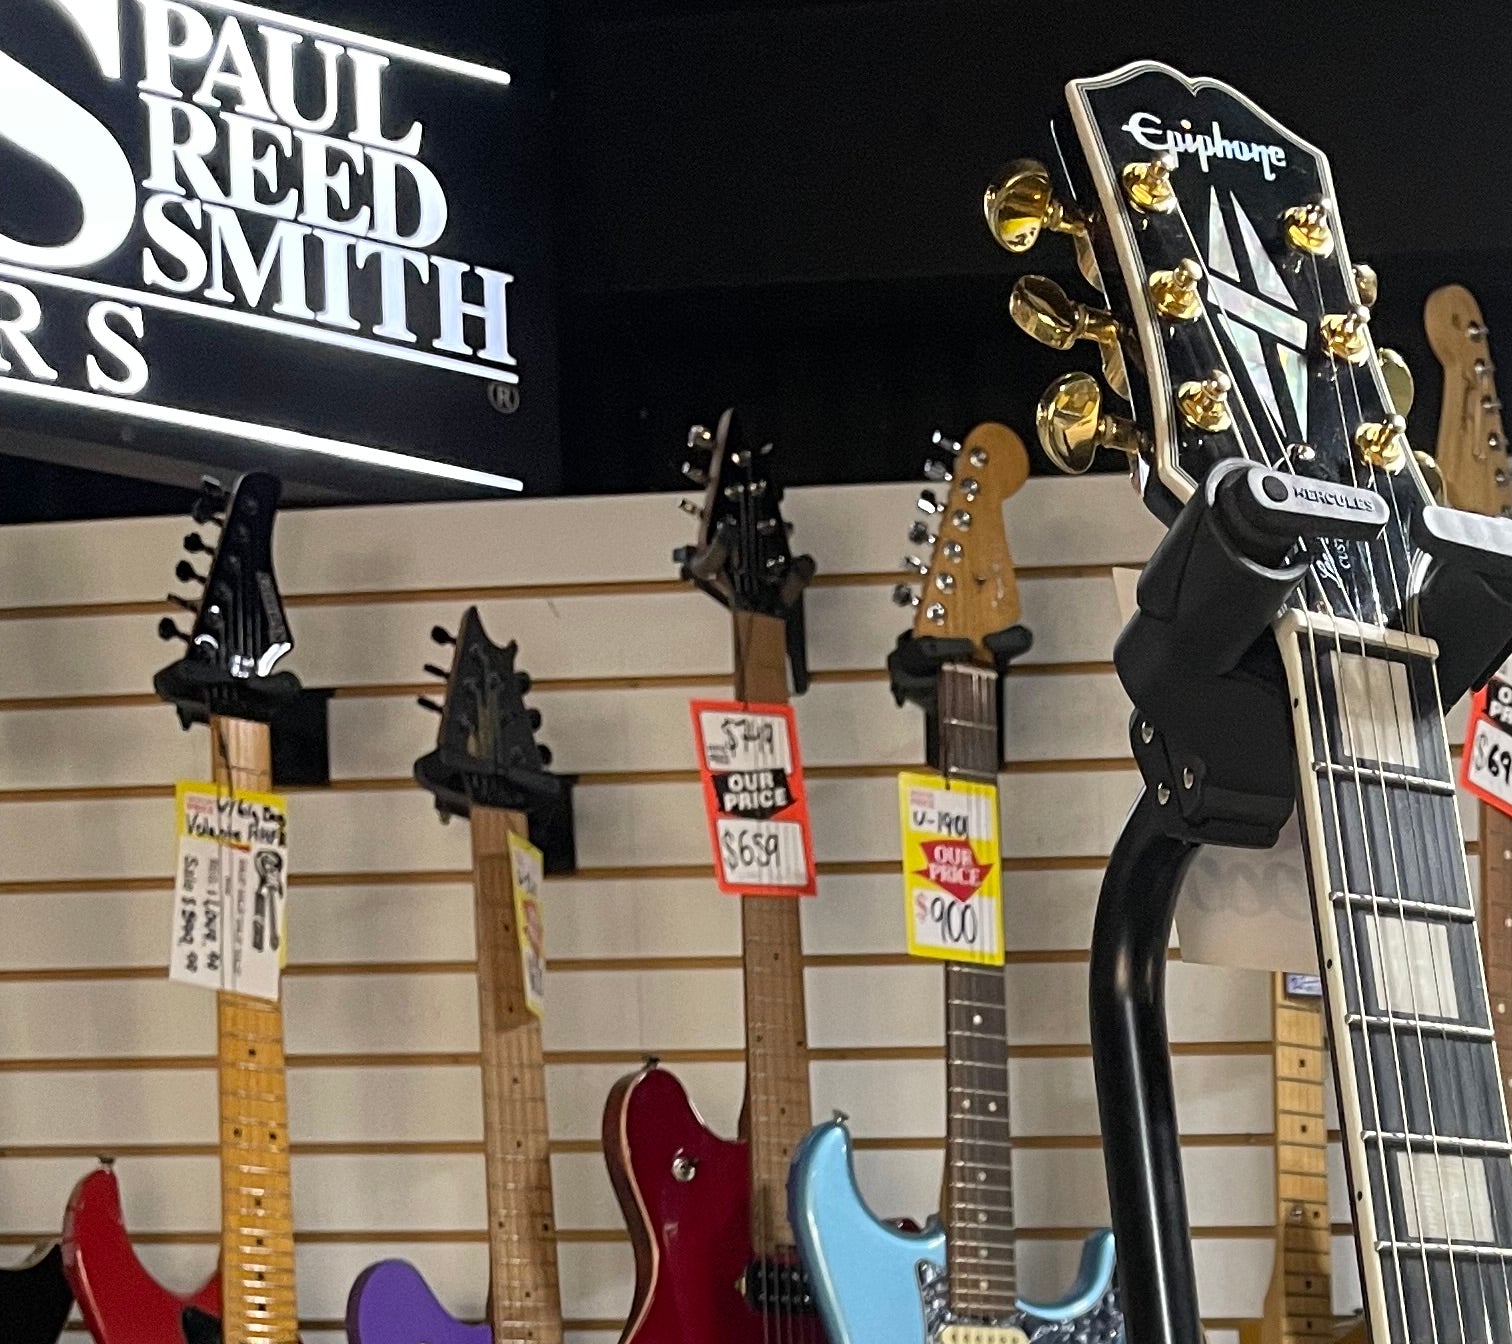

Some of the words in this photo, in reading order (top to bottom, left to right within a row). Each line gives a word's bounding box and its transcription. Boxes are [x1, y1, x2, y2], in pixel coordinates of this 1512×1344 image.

[138, 0, 423, 156] PAUL
[1121, 111, 1287, 182] Epiphone
[139, 92, 449, 250] REED
[143, 192, 518, 367] SMITH
[1293, 486, 1375, 513] HERCULES
[722, 787, 787, 812] PRICE
[727, 771, 775, 791] OUR
[722, 829, 781, 871] $659
[933, 845, 974, 867] OUR
[928, 863, 981, 887] PRICE
[916, 892, 978, 944] $900
